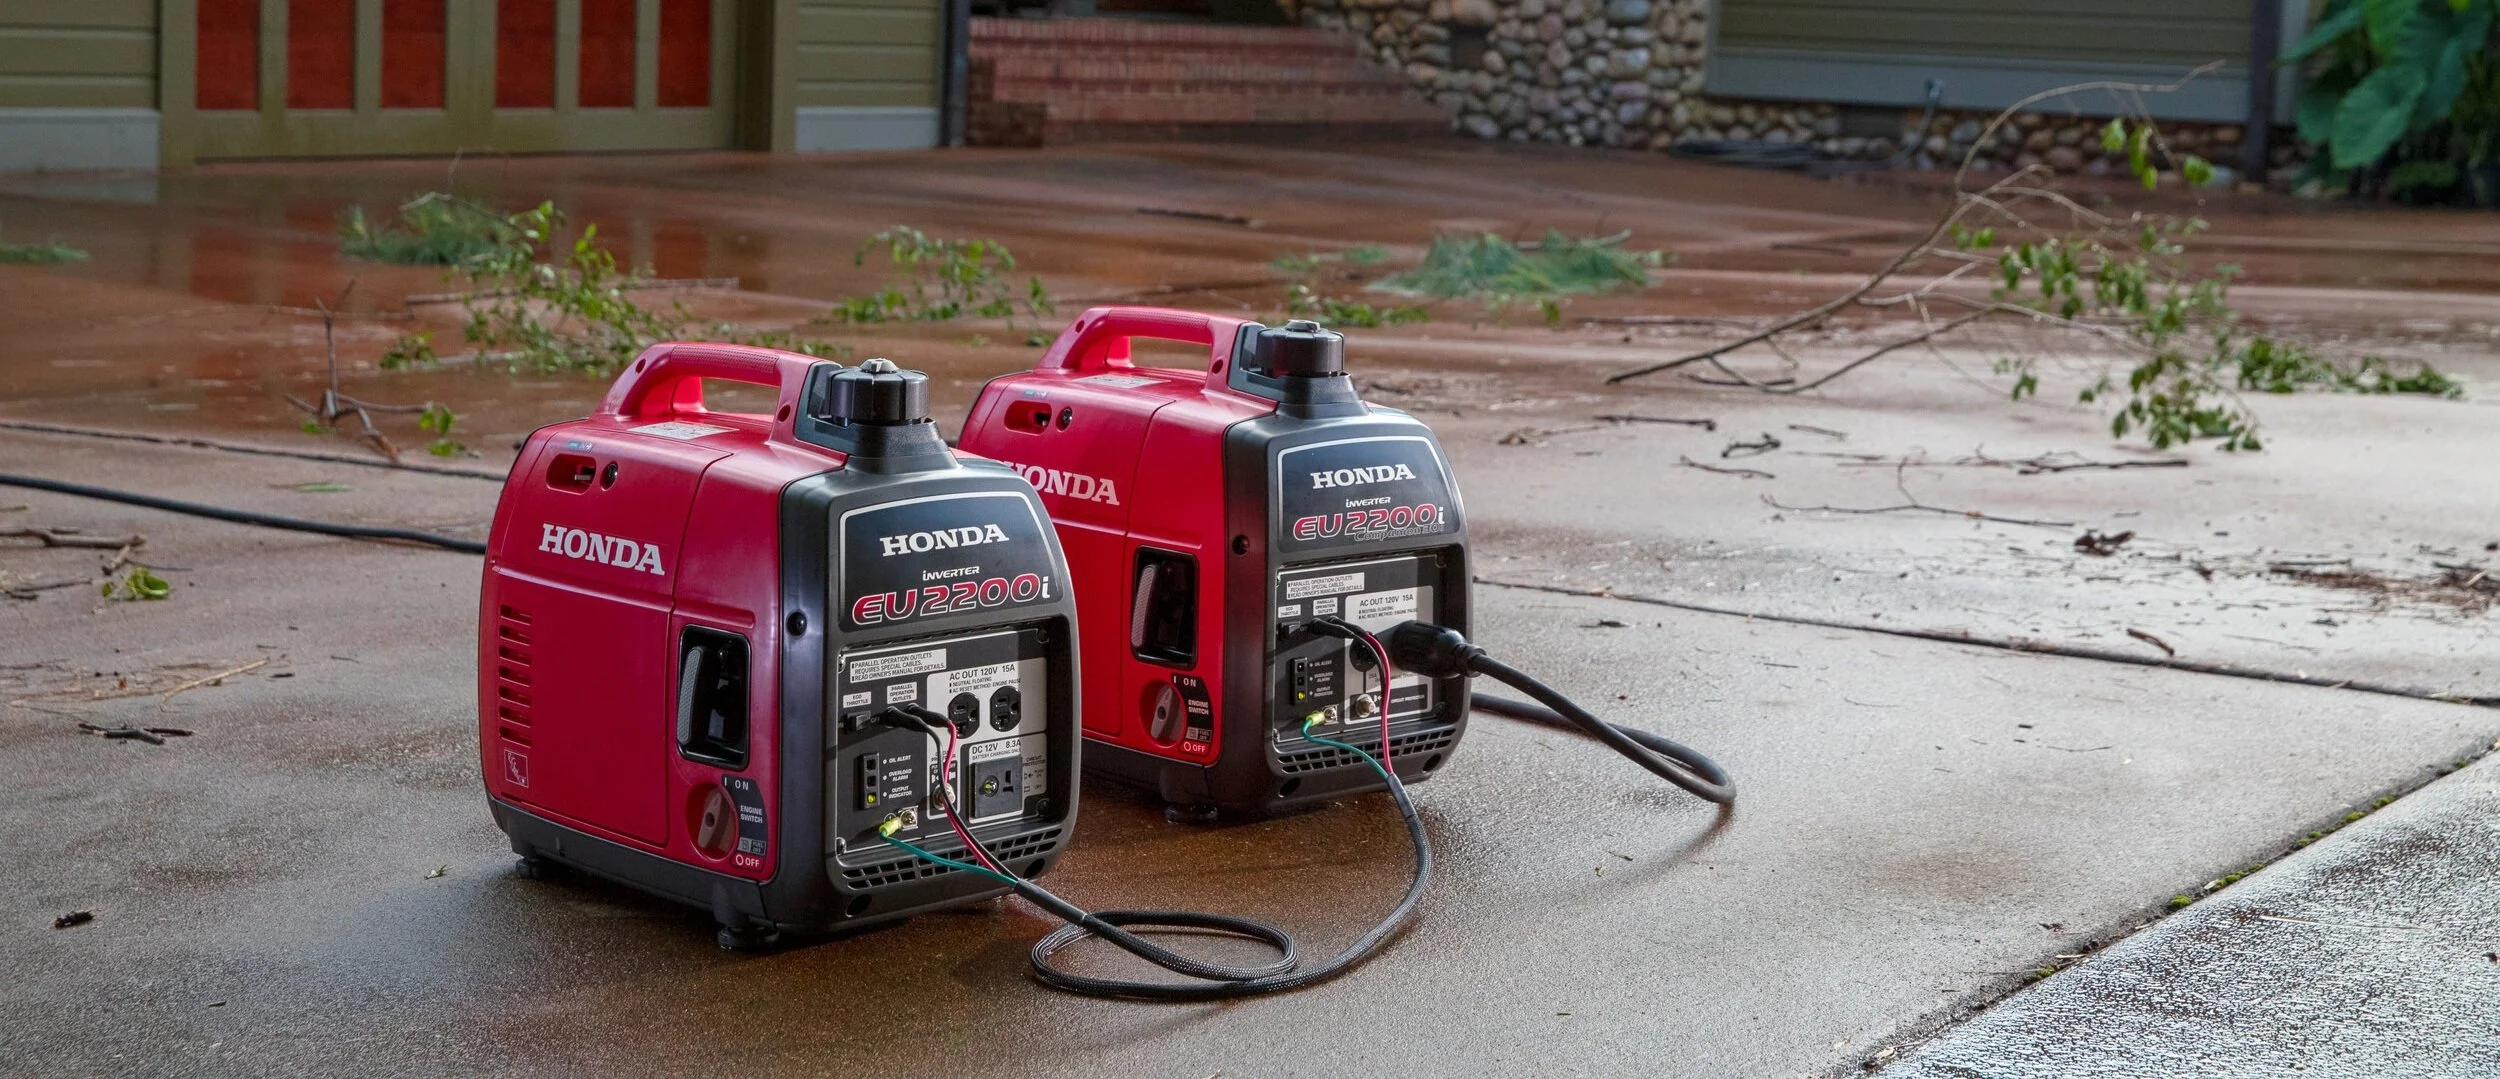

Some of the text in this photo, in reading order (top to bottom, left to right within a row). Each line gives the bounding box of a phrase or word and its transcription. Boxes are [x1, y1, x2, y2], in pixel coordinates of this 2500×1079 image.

[1310, 464, 1416, 490] HONDA
[880, 524, 1010, 557] HONDA
[538, 523, 665, 576] HONDA
[855, 653, 932, 668] PARALLEL OPERATION OUTLETS
[855, 666, 881, 675] REQUIRES
[881, 663, 899, 672] SPECIAL
[949, 664, 1015, 681] AC OUT 120V 15A
[855, 673, 868, 681] READ
[892, 668, 913, 676] MANUAL
[1183, 678, 1196, 687] ON
[1188, 699, 1208, 708] ENGINE
[1188, 706, 1209, 715] SWITCH
[972, 739, 1022, 754] DC 12V 8.3A
[1192, 744, 1206, 753] OFF
[889, 768, 912, 777] OVERLOAD
[892, 774, 909, 782] ALARM
[734, 780, 749, 791] ON
[740, 805, 763, 815] ENGINE
[740, 814, 763, 824] SWITCH
[745, 858, 760, 867] OFF
